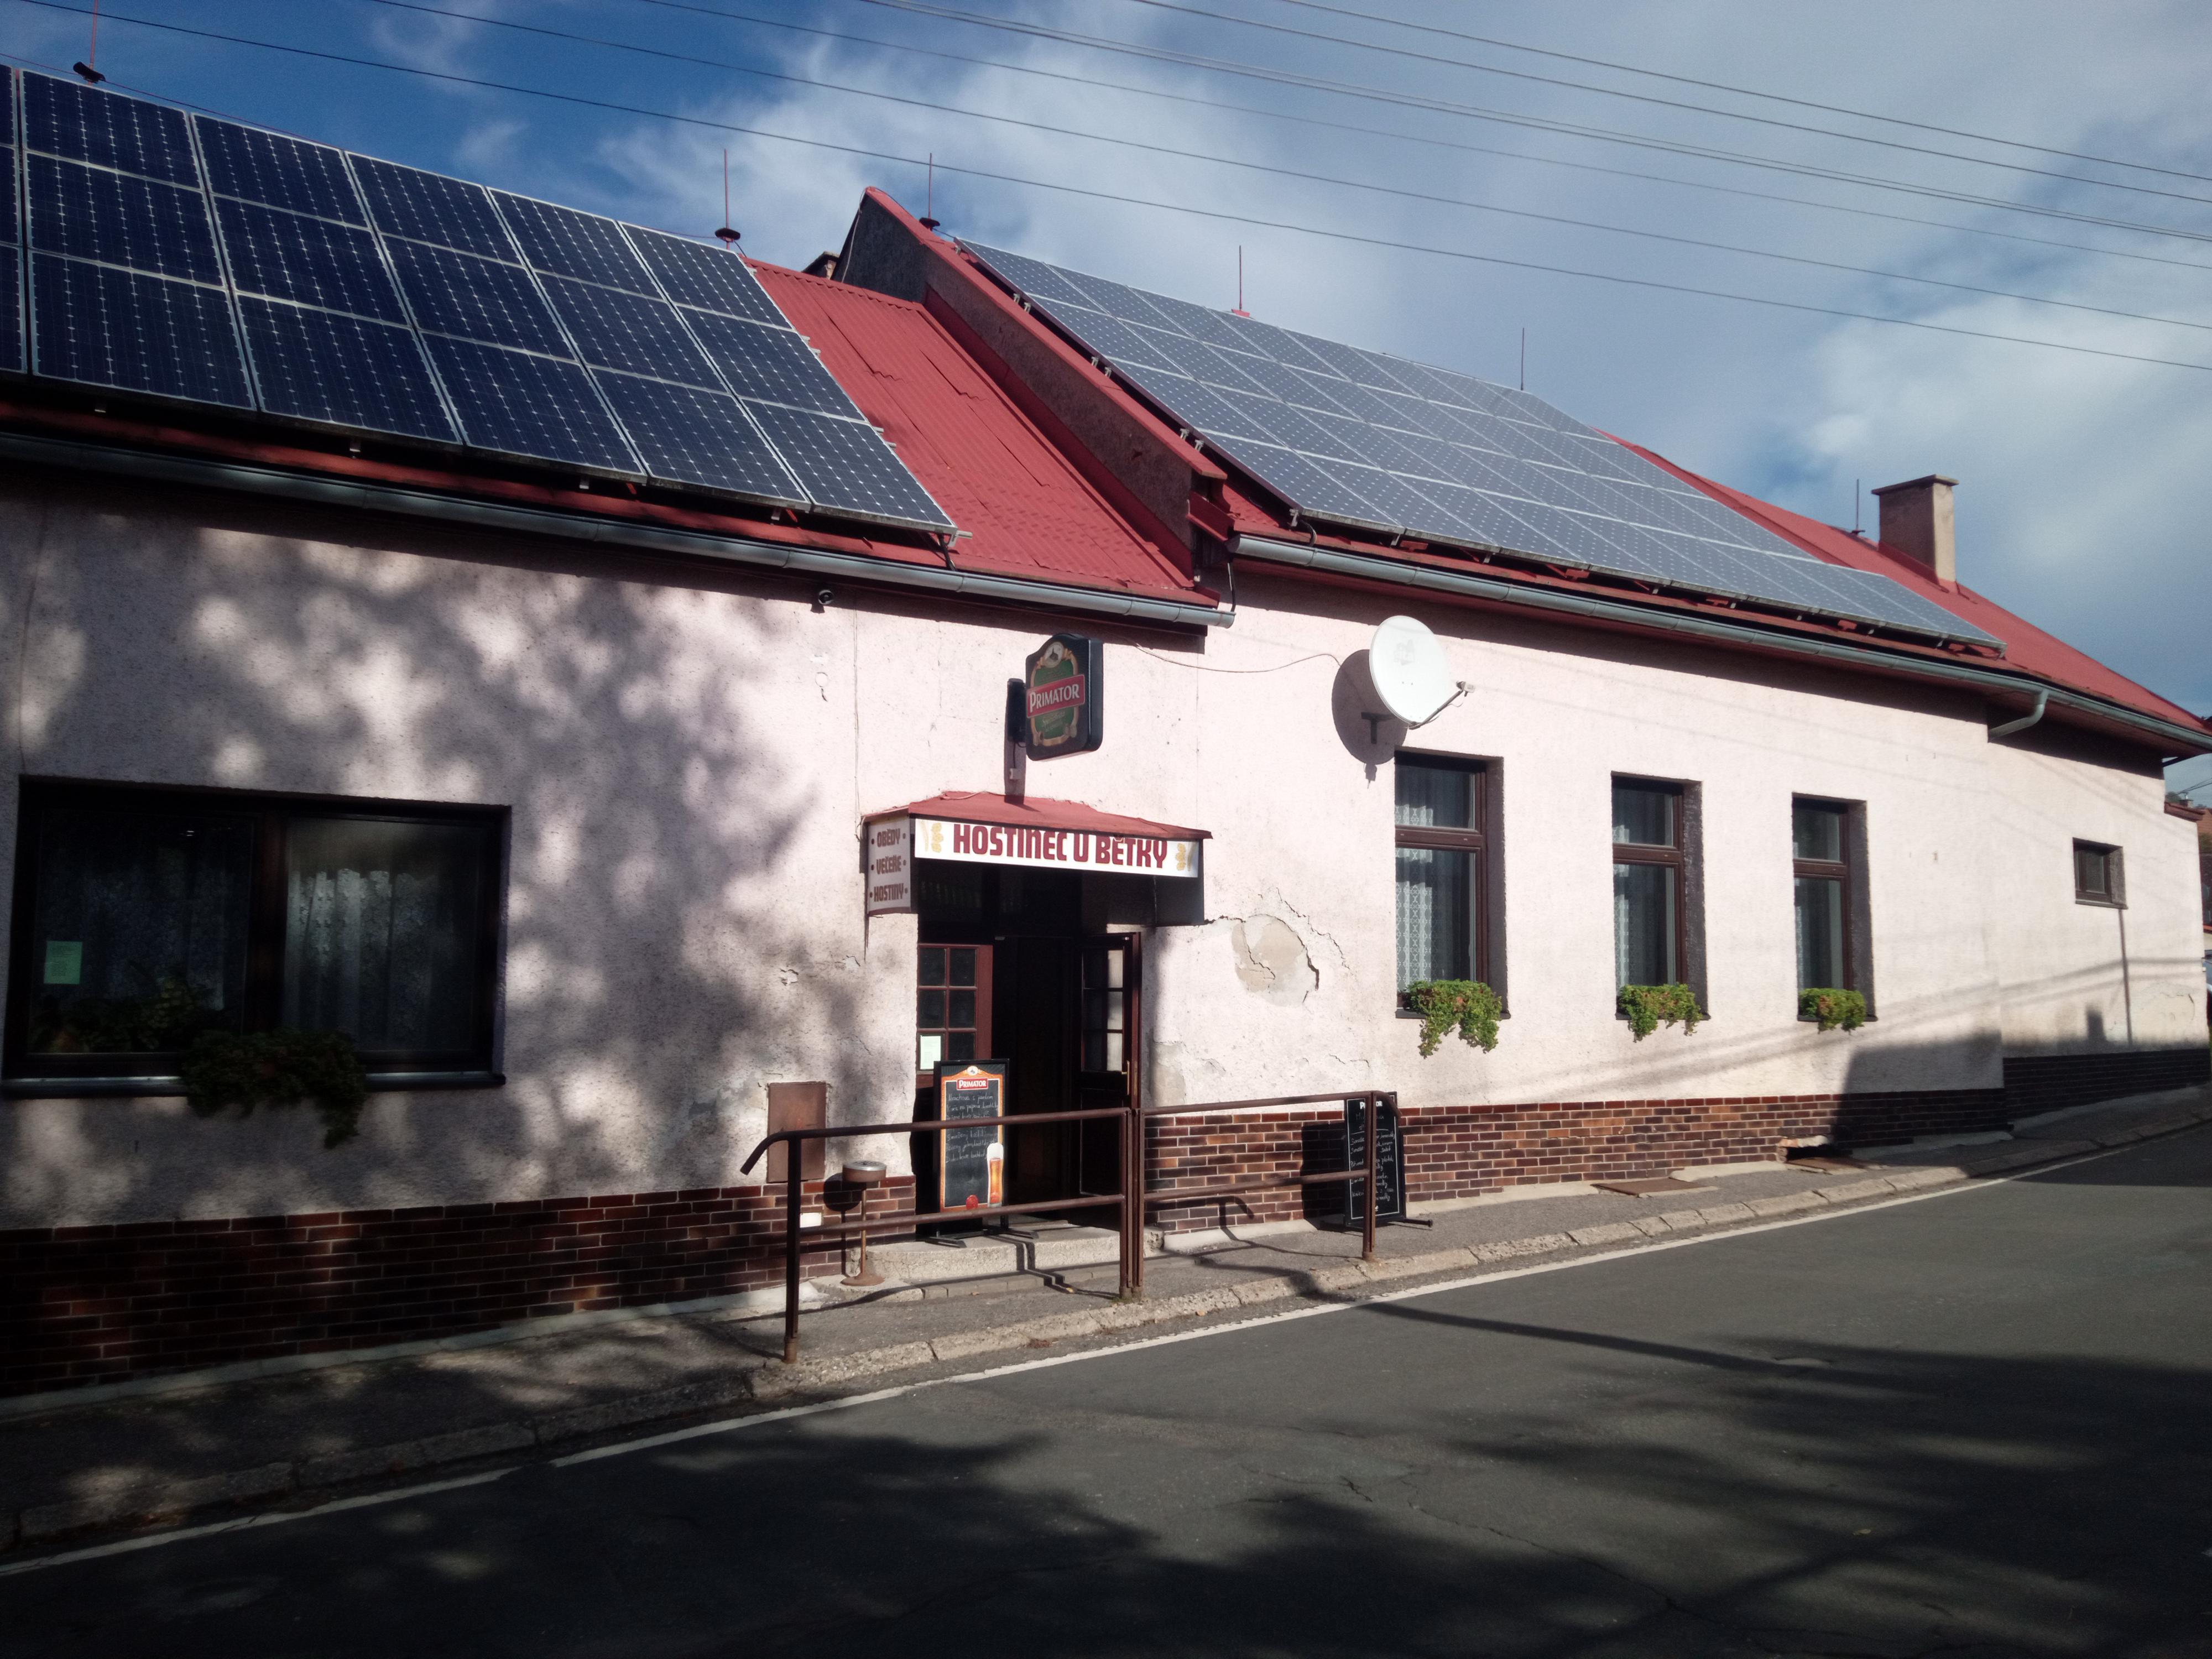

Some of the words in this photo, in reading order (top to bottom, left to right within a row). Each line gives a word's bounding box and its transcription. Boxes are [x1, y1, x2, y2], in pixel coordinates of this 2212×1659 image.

[1030, 684, 1079, 713] PRIMATOR
[877, 828, 900, 847] OBĚDY
[953, 823, 1067, 861] HOSTINEC
[1073, 832, 1089, 862] U
[874, 883, 904, 902] HOSTINY
[958, 1079, 987, 1089] PRIMATOR
